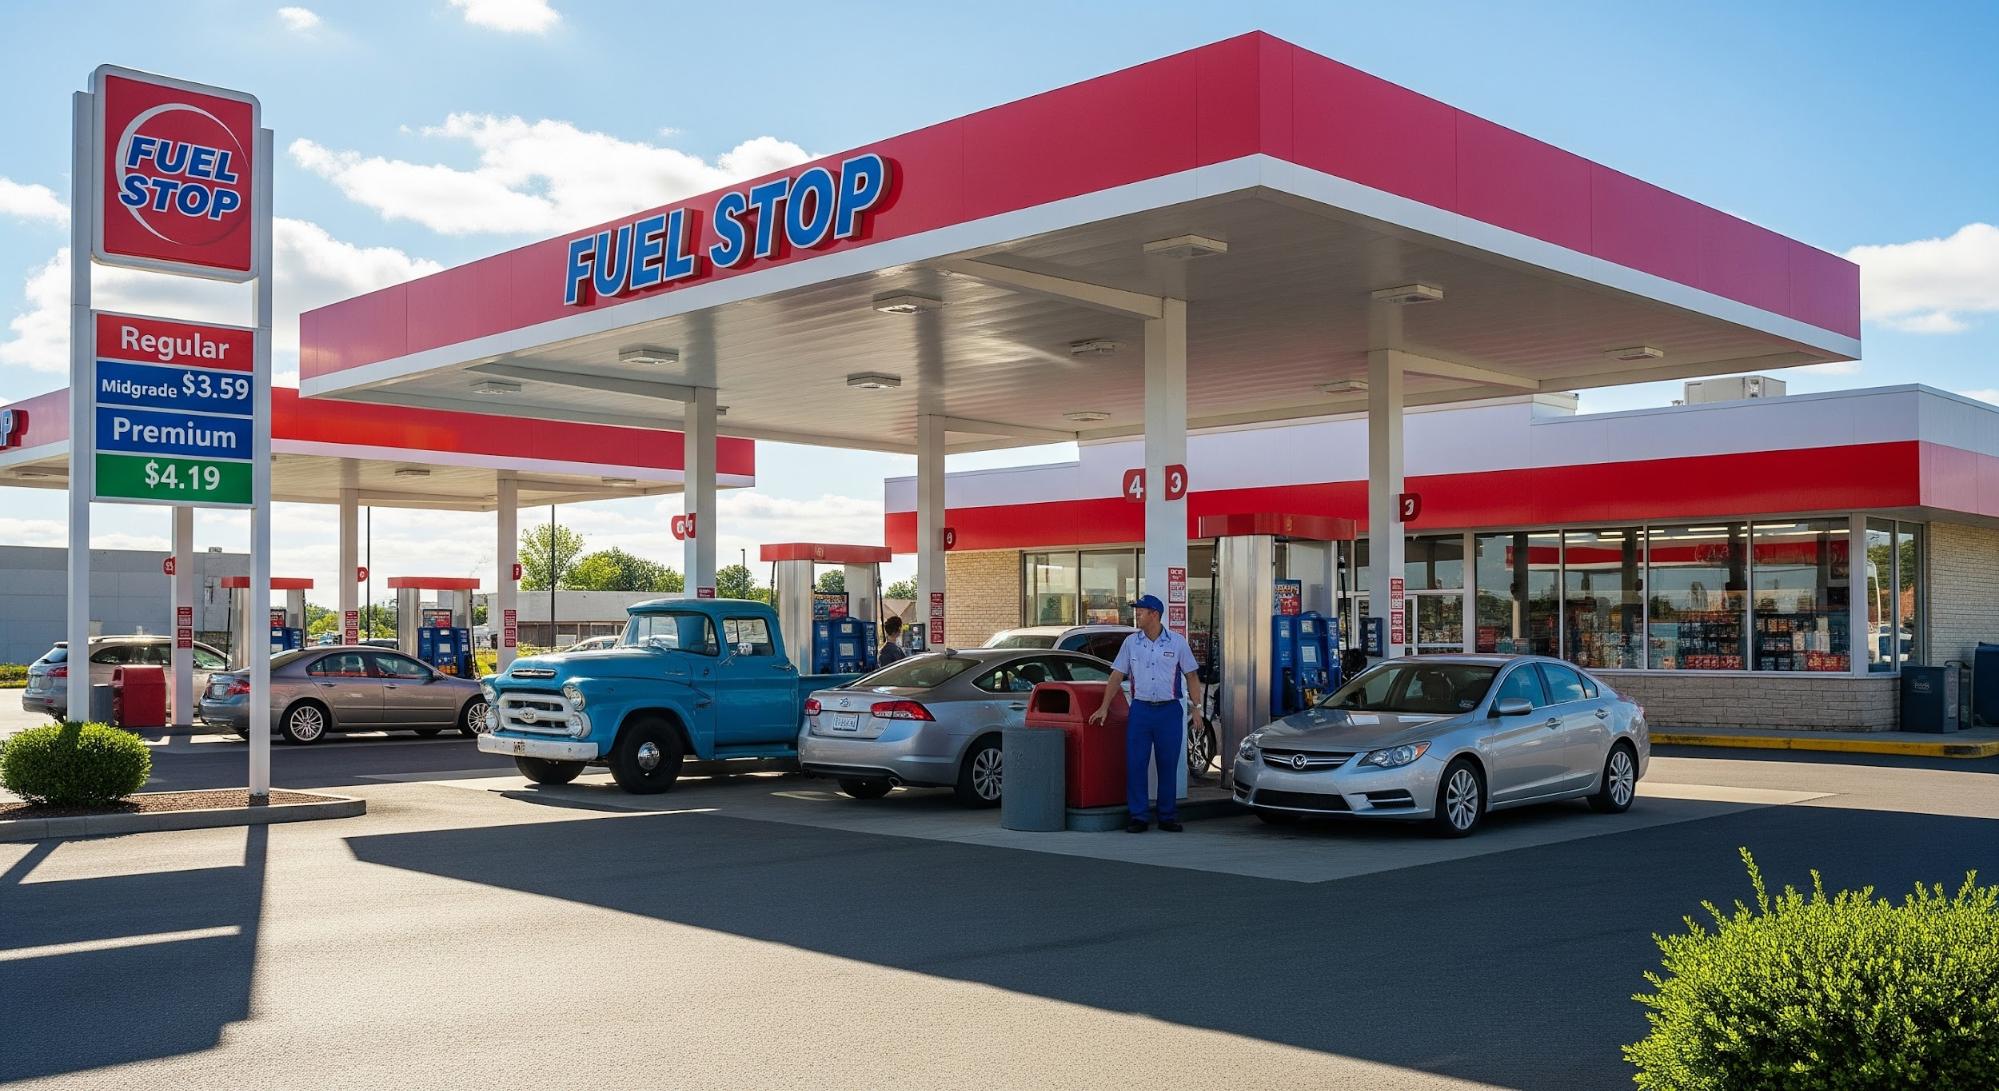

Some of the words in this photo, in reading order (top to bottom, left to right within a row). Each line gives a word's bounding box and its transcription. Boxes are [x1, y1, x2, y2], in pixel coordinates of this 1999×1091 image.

[125, 134, 239, 185] FUEL
[118, 173, 242, 221] STOP
[564, 207, 696, 306] FUEL
[708, 153, 886, 269] STOP
[120, 325, 230, 361] Regular
[101, 378, 178, 399] Midgrade
[182, 371, 250, 400] $3.59
[113, 416, 237, 449] Premium
[145, 459, 221, 491] $4.19
[1128, 474, 1144, 499] 4
[1170, 472, 1182, 493] 3
[1404, 498, 1415, 516] 3
